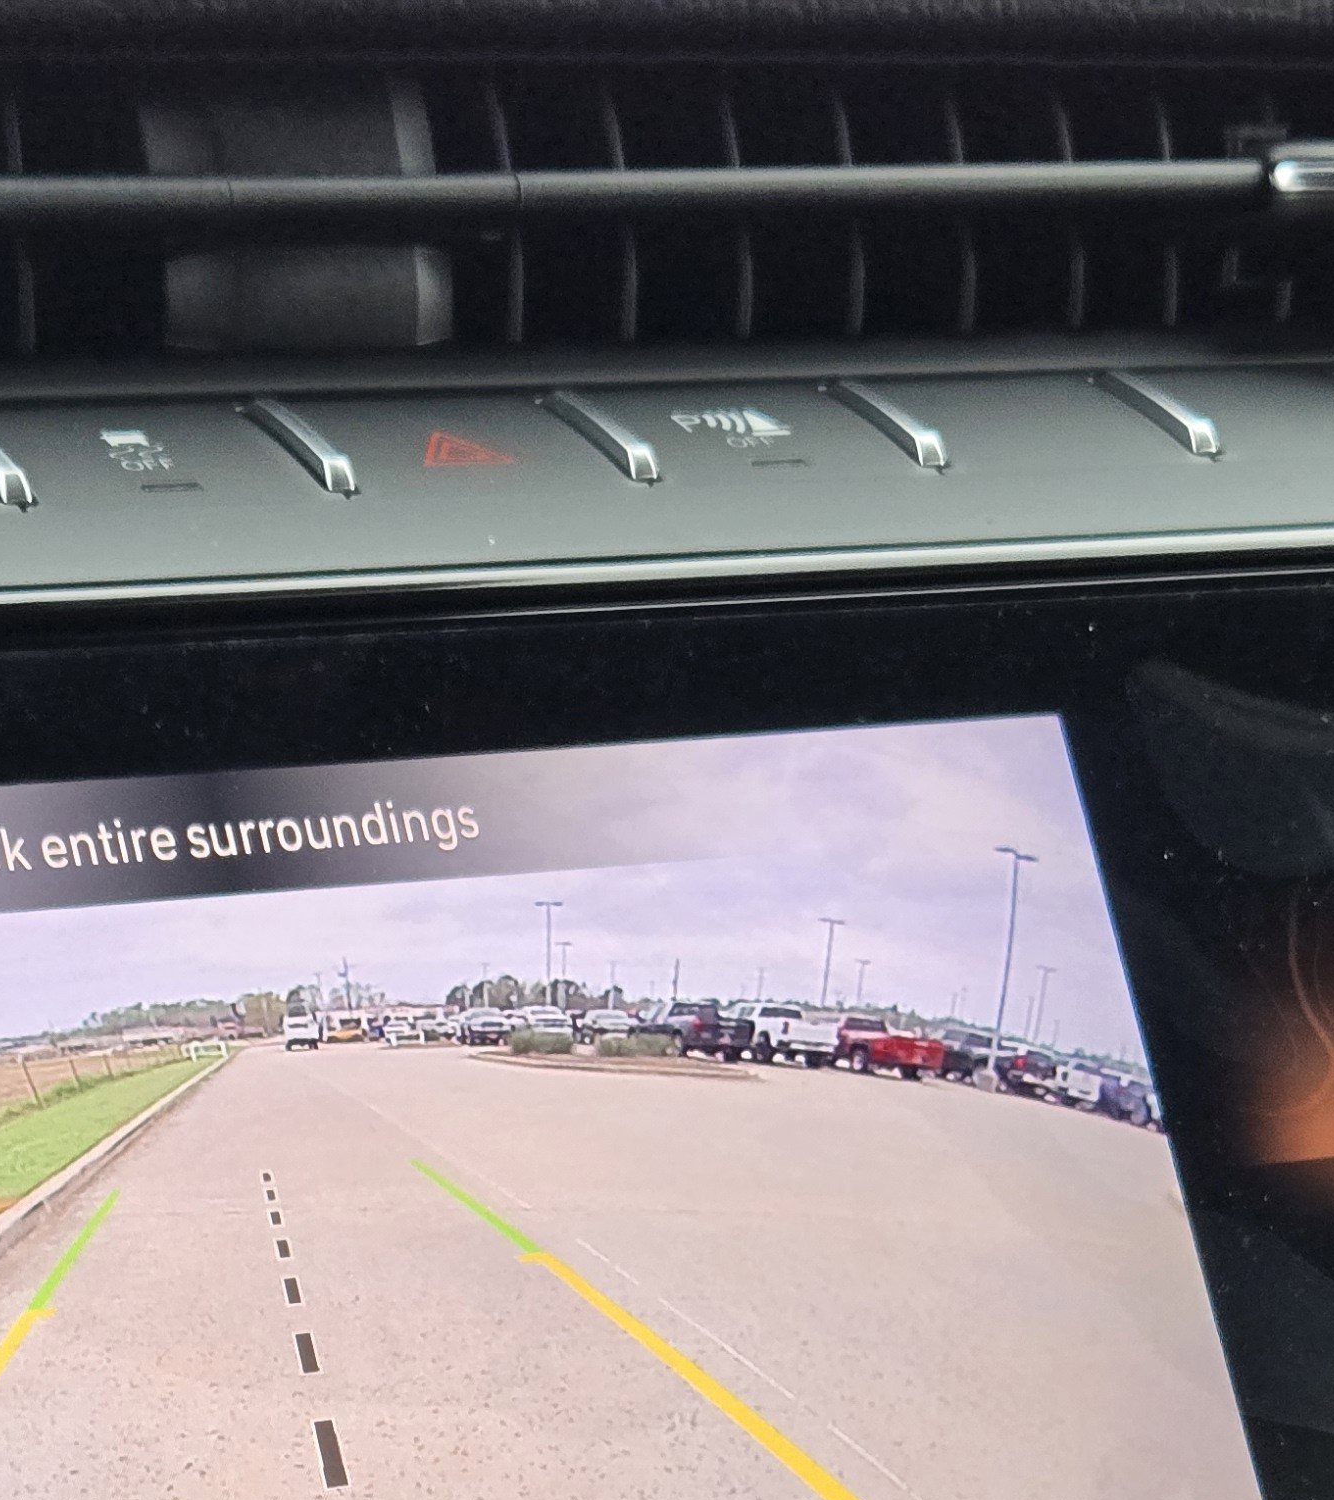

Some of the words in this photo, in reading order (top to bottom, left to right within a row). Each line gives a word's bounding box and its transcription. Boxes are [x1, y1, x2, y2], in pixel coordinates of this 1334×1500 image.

[726, 436, 773, 448] OFF
[120, 457, 175, 471] OFF
[41, 819, 177, 869] entire
[188, 801, 480, 860] surroundings
